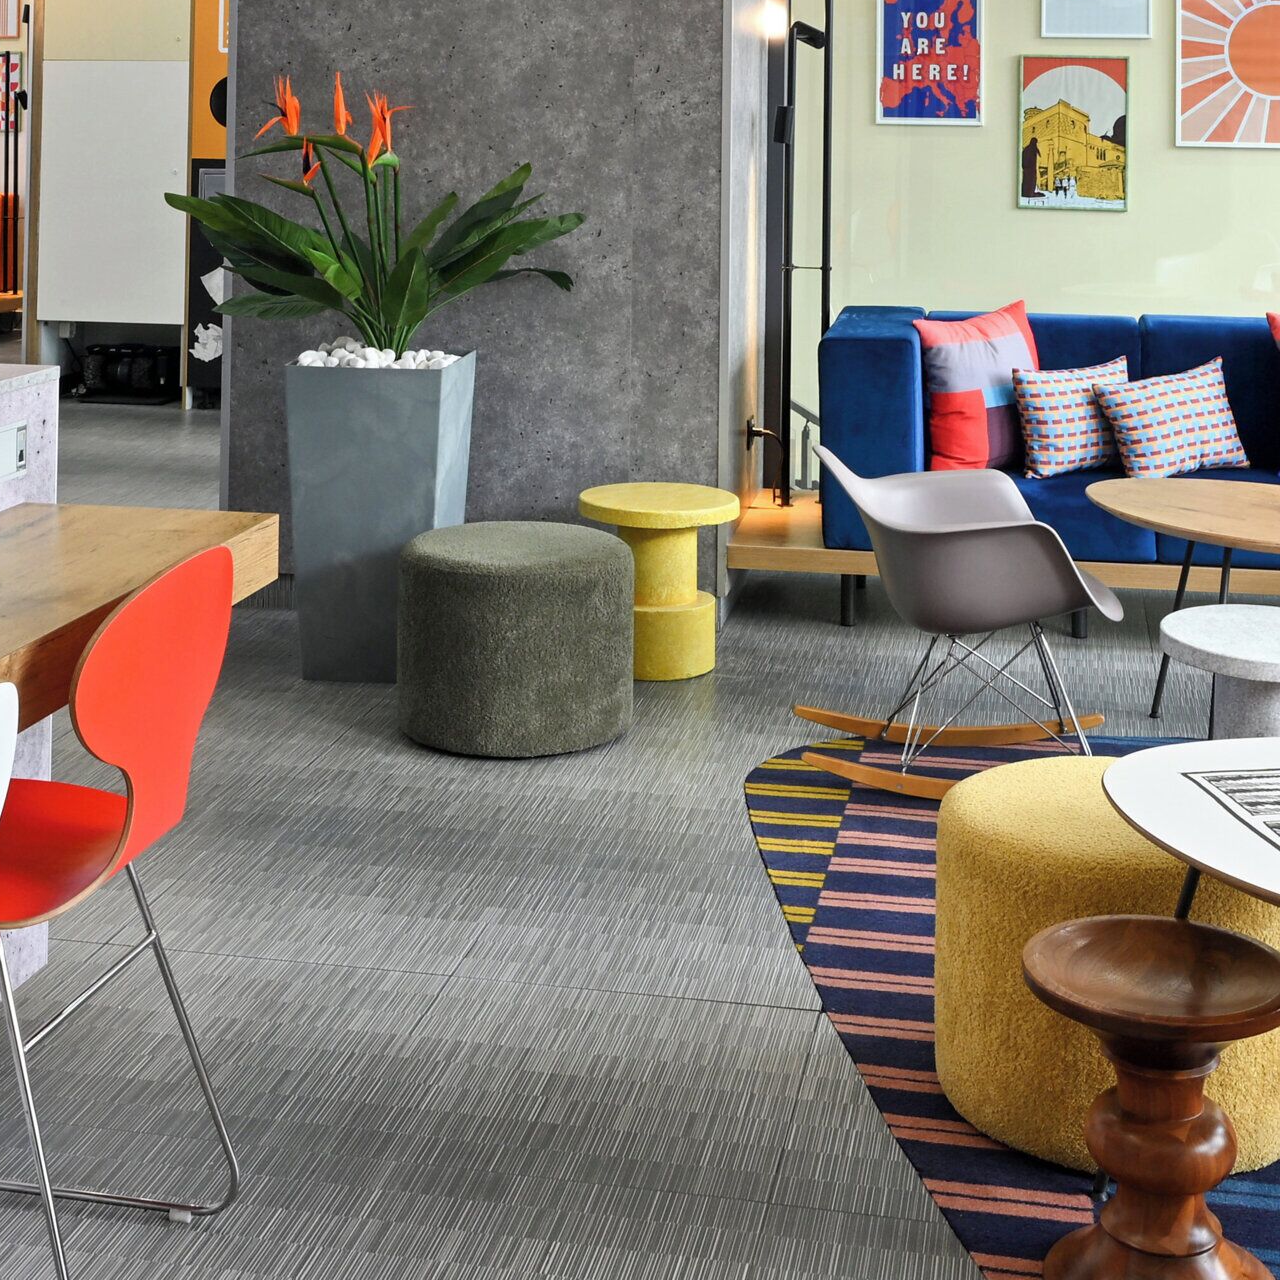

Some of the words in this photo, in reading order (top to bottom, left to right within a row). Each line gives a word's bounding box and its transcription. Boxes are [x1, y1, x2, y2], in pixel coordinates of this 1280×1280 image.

[900, 12, 945, 28] YOU
[900, 38, 946, 54] ARE
[893, 64, 969, 80] HERE!
